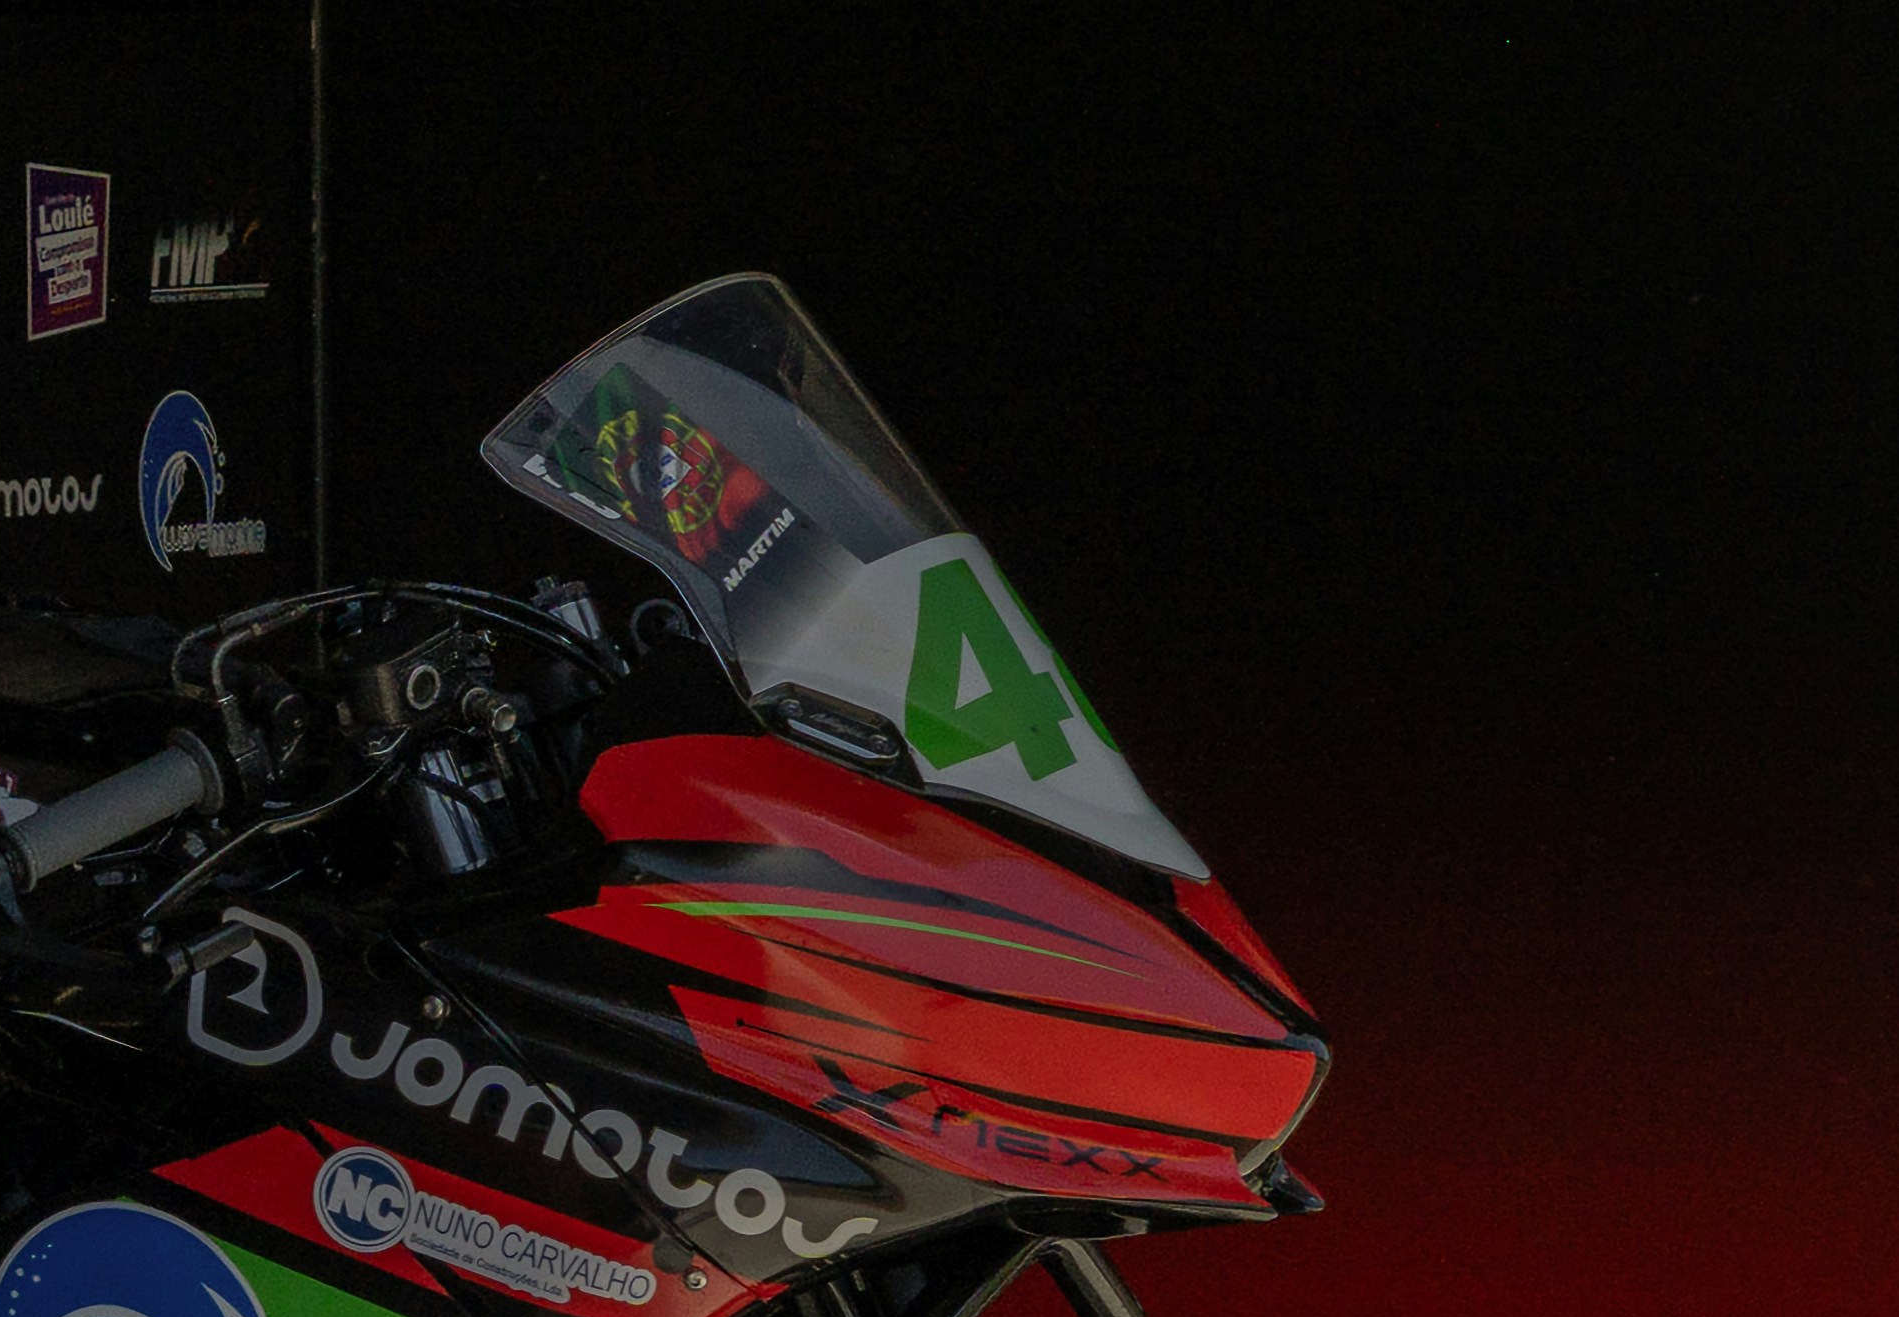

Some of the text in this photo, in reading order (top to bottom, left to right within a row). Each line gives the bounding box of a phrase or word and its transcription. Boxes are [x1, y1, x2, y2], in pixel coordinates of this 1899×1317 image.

[38, 193, 95, 235] Loulé
[722, 508, 796, 592] MARTIM
[905, 557, 1121, 781] 4
[326, 1166, 405, 1233] NC
[413, 1198, 651, 1301] NUNO CARVALHO
